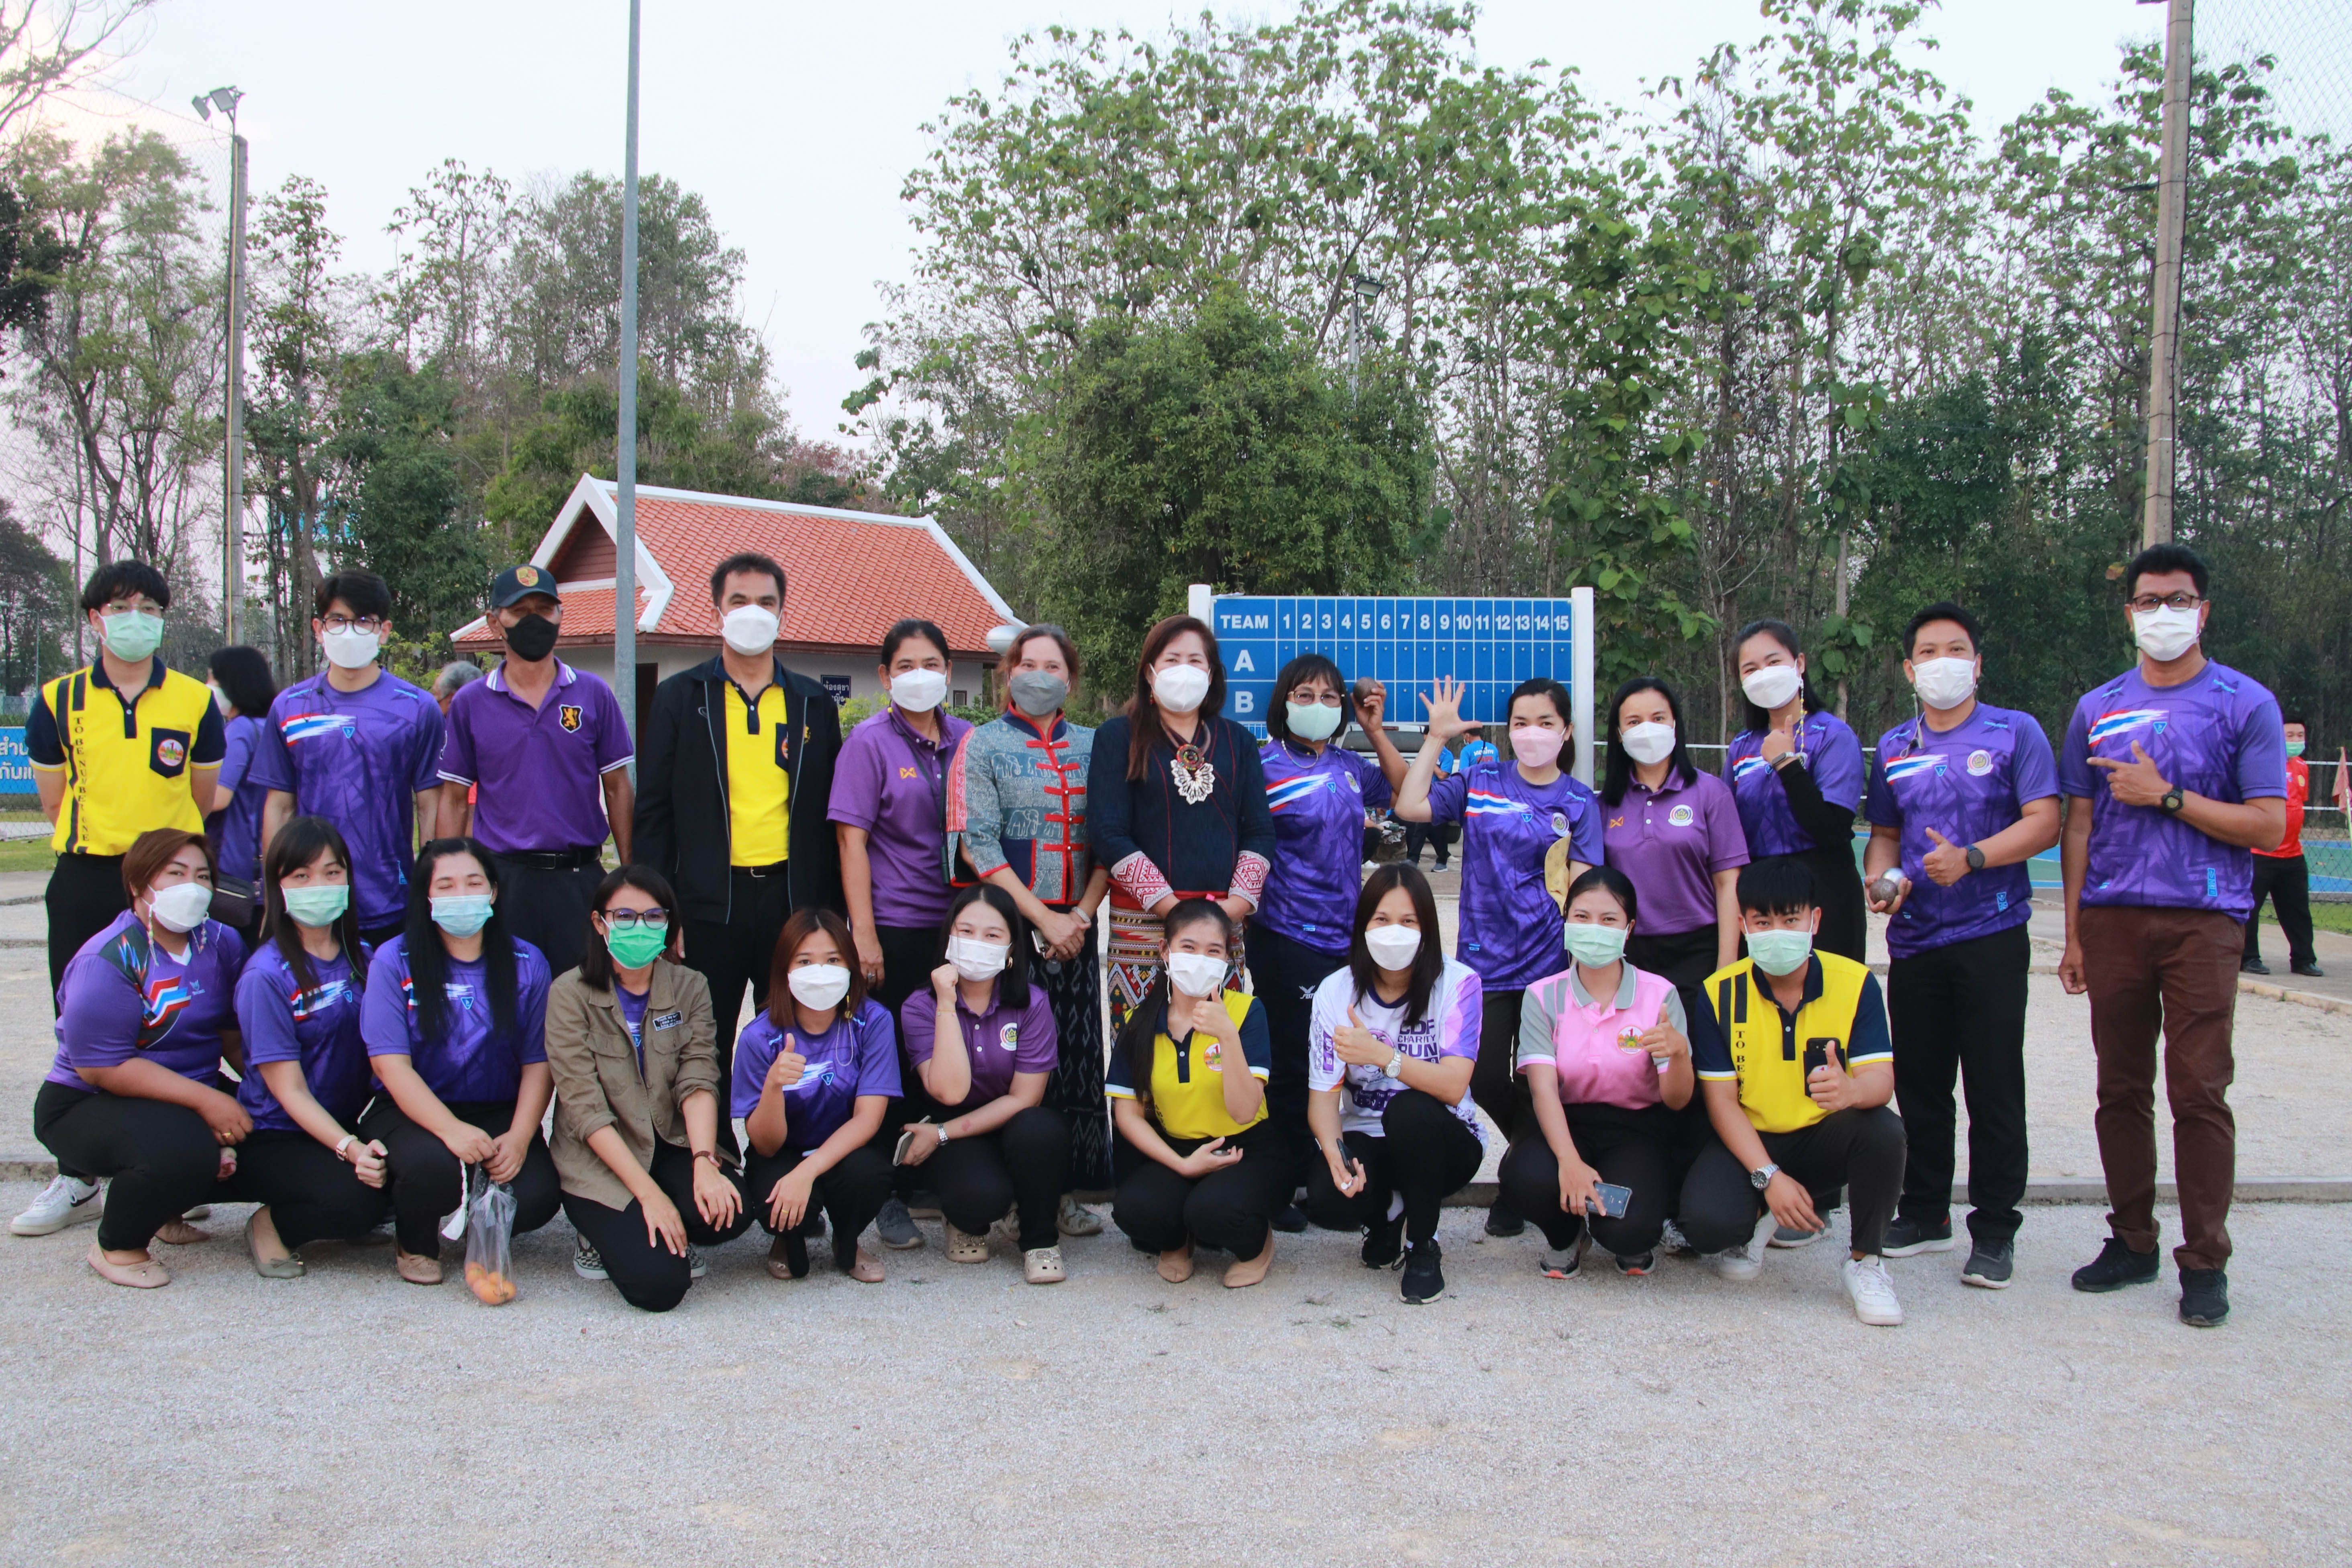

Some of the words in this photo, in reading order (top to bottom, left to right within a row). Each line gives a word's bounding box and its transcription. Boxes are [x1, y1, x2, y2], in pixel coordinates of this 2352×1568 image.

[1220, 615, 1268, 629] TEAM
[1283, 614, 1290, 628] 1
[1301, 614, 1312, 629] 2
[1321, 614, 1332, 629] 3
[1341, 614, 1351, 629] 4
[1361, 614, 1371, 629] 5
[1381, 614, 1391, 629] 6
[1401, 615, 1410, 629] 7
[1420, 614, 1430, 629] 8
[1440, 615, 1450, 629] 9
[1456, 615, 1471, 630] 10
[1475, 615, 1489, 630] 11
[1495, 615, 1510, 630] 12
[1514, 615, 1530, 630] 13
[1534, 616, 1550, 630] 14
[1553, 616, 1569, 630] 15
[1234, 650, 1255, 672] A
[831, 693, 846, 704] ญิง
[1235, 691, 1254, 713] B
[74, 717, 84, 734] TO
[75, 738, 84, 755] BE
[1400, 1019, 1435, 1035] CDF
[1325, 1037, 1333, 1054] KM
[1397, 1034, 1436, 1043] CHARITY
[1735, 1030, 1745, 1049] TO
[1397, 1042, 1438, 1057] RUN
[1326, 1057, 1333, 1066] 5
[1736, 1055, 1745, 1073] BE
